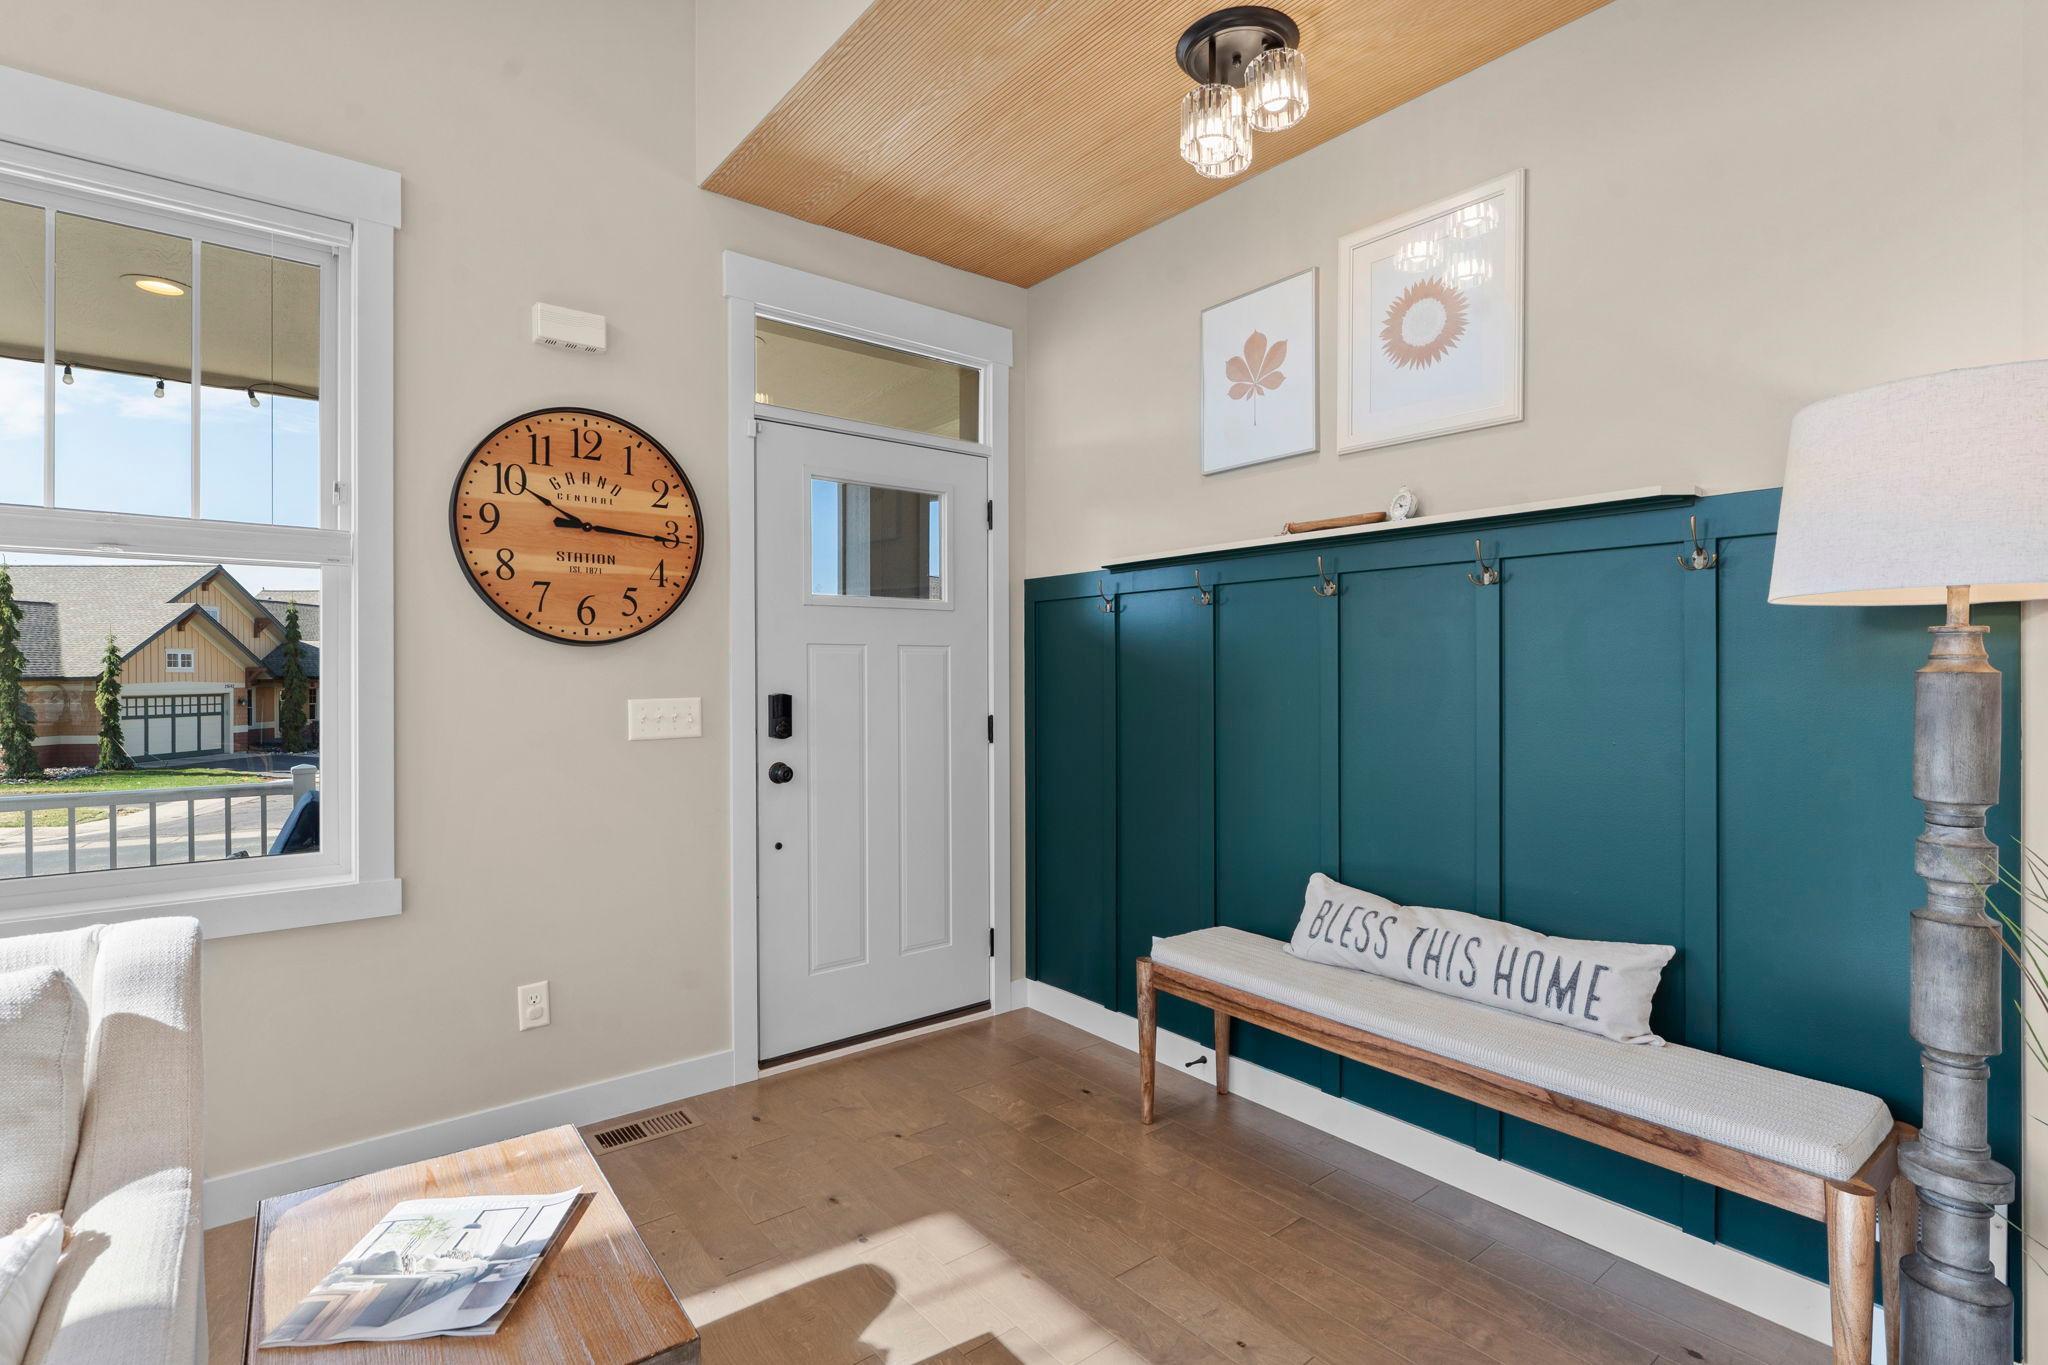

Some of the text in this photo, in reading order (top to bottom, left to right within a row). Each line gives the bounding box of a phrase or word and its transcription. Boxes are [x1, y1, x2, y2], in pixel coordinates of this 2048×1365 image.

[528, 434, 553, 467] 11
[570, 427, 602, 461] 12
[624, 446, 633, 476] 1
[492, 462, 527, 495] 10
[549, 472, 622, 497] GRAND
[557, 493, 614, 505] CENTRAL
[651, 479, 669, 509] 2
[479, 503, 500, 534] 9
[662, 521, 680, 549] 3
[496, 548, 515, 580] 8
[556, 551, 616, 565] STATION
[585, 567, 602, 575] 1871
[650, 559, 668, 588] 4
[532, 581, 551, 612] 7
[577, 595, 596, 625] 6
[622, 587, 637, 616] 5
[1309, 900, 1609, 1021] BLESS THIS HOME
